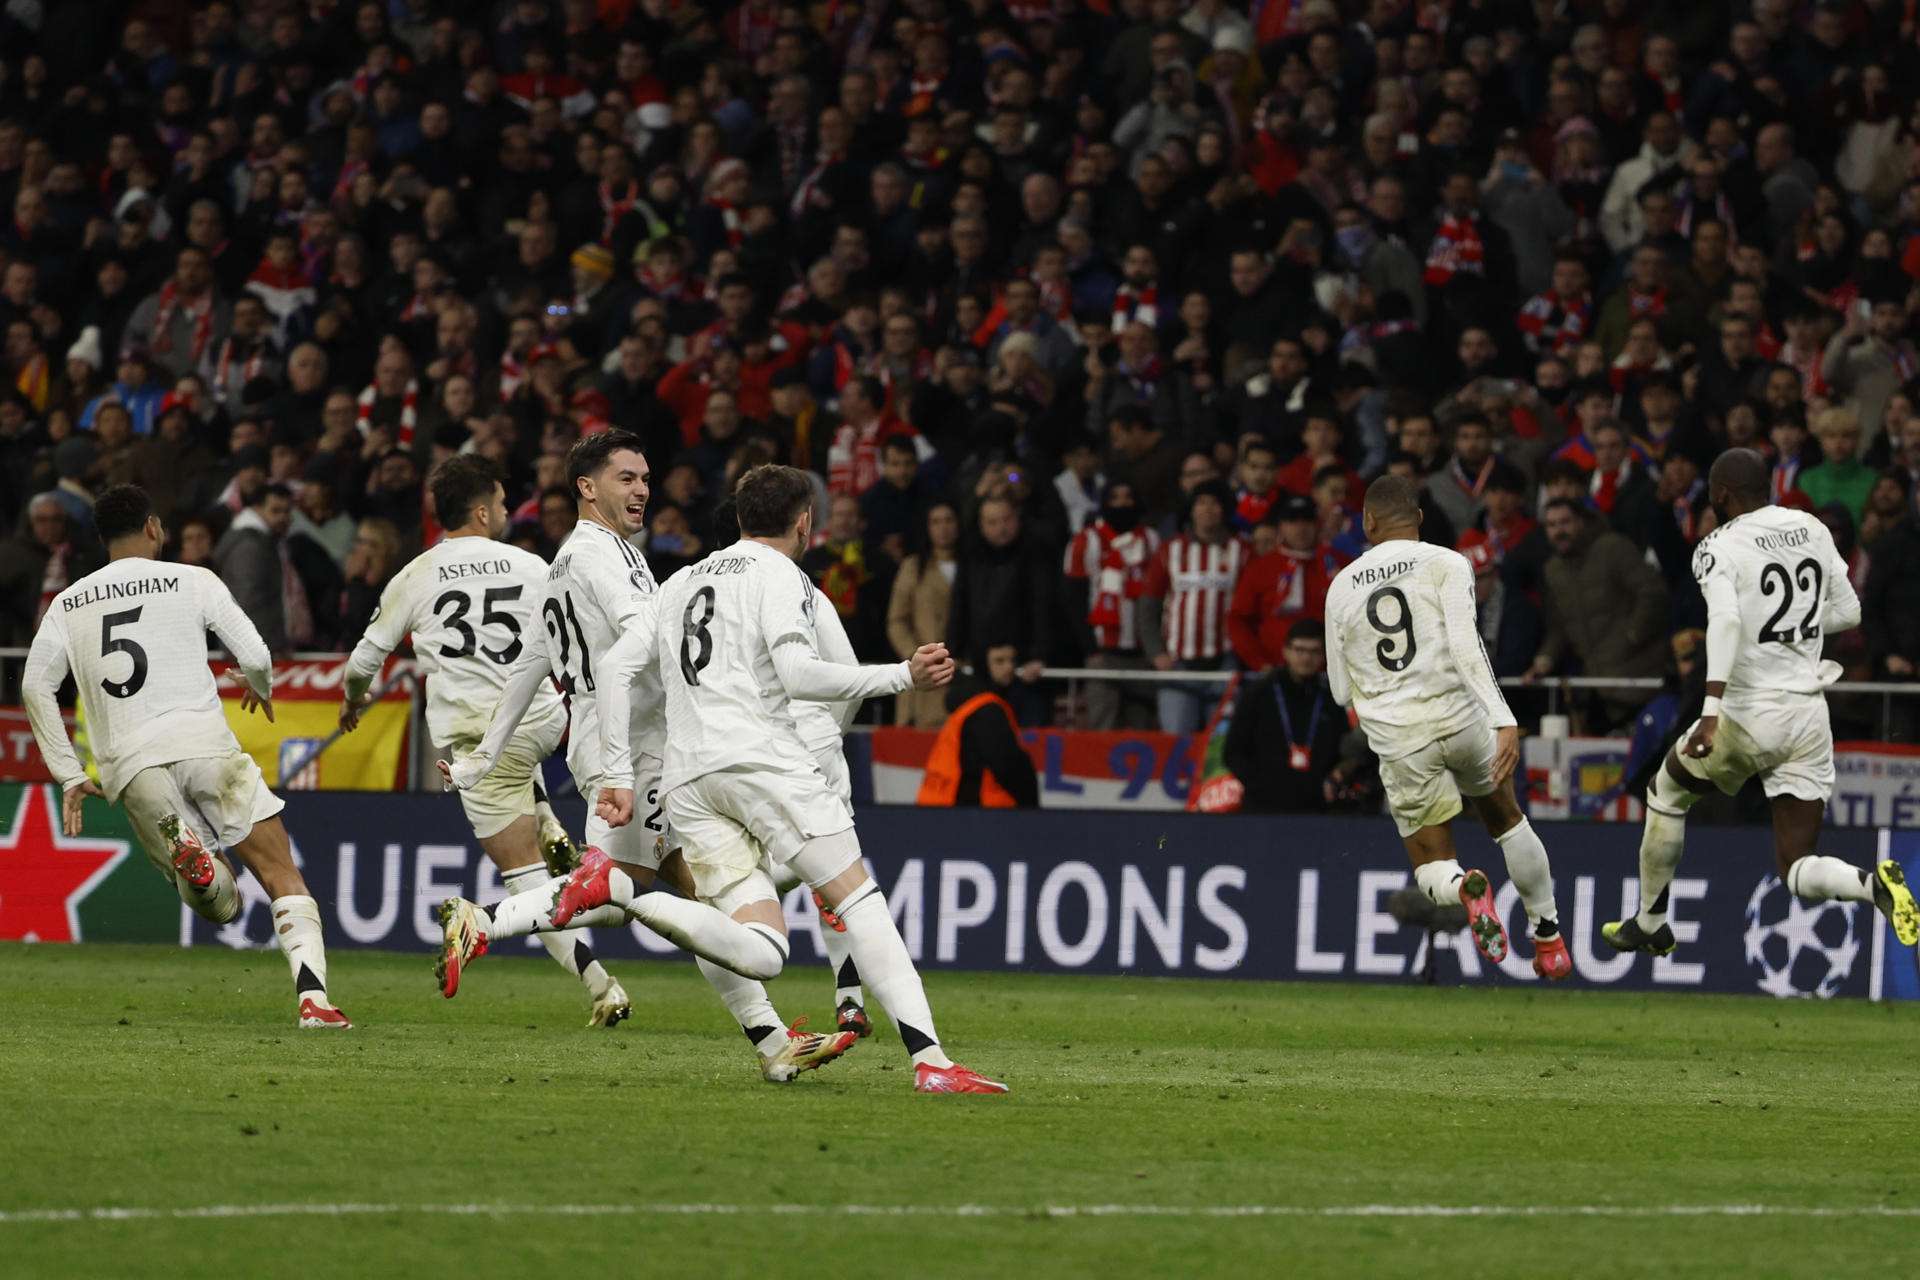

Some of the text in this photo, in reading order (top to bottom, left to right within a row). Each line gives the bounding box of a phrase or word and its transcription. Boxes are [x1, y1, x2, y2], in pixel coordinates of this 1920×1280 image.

[62, 577, 179, 612] BELLINGHAM
[438, 559, 511, 582] ASENCIO
[1759, 557, 1823, 644] 22
[101, 604, 148, 699] 5
[433, 584, 524, 665] 35
[543, 590, 596, 692] 21
[680, 585, 716, 686] 8
[1366, 586, 1417, 672] 9
[644, 789, 671, 836] 2
[336, 842, 594, 949] UE
[630, 856, 1249, 972] AMPIONS
